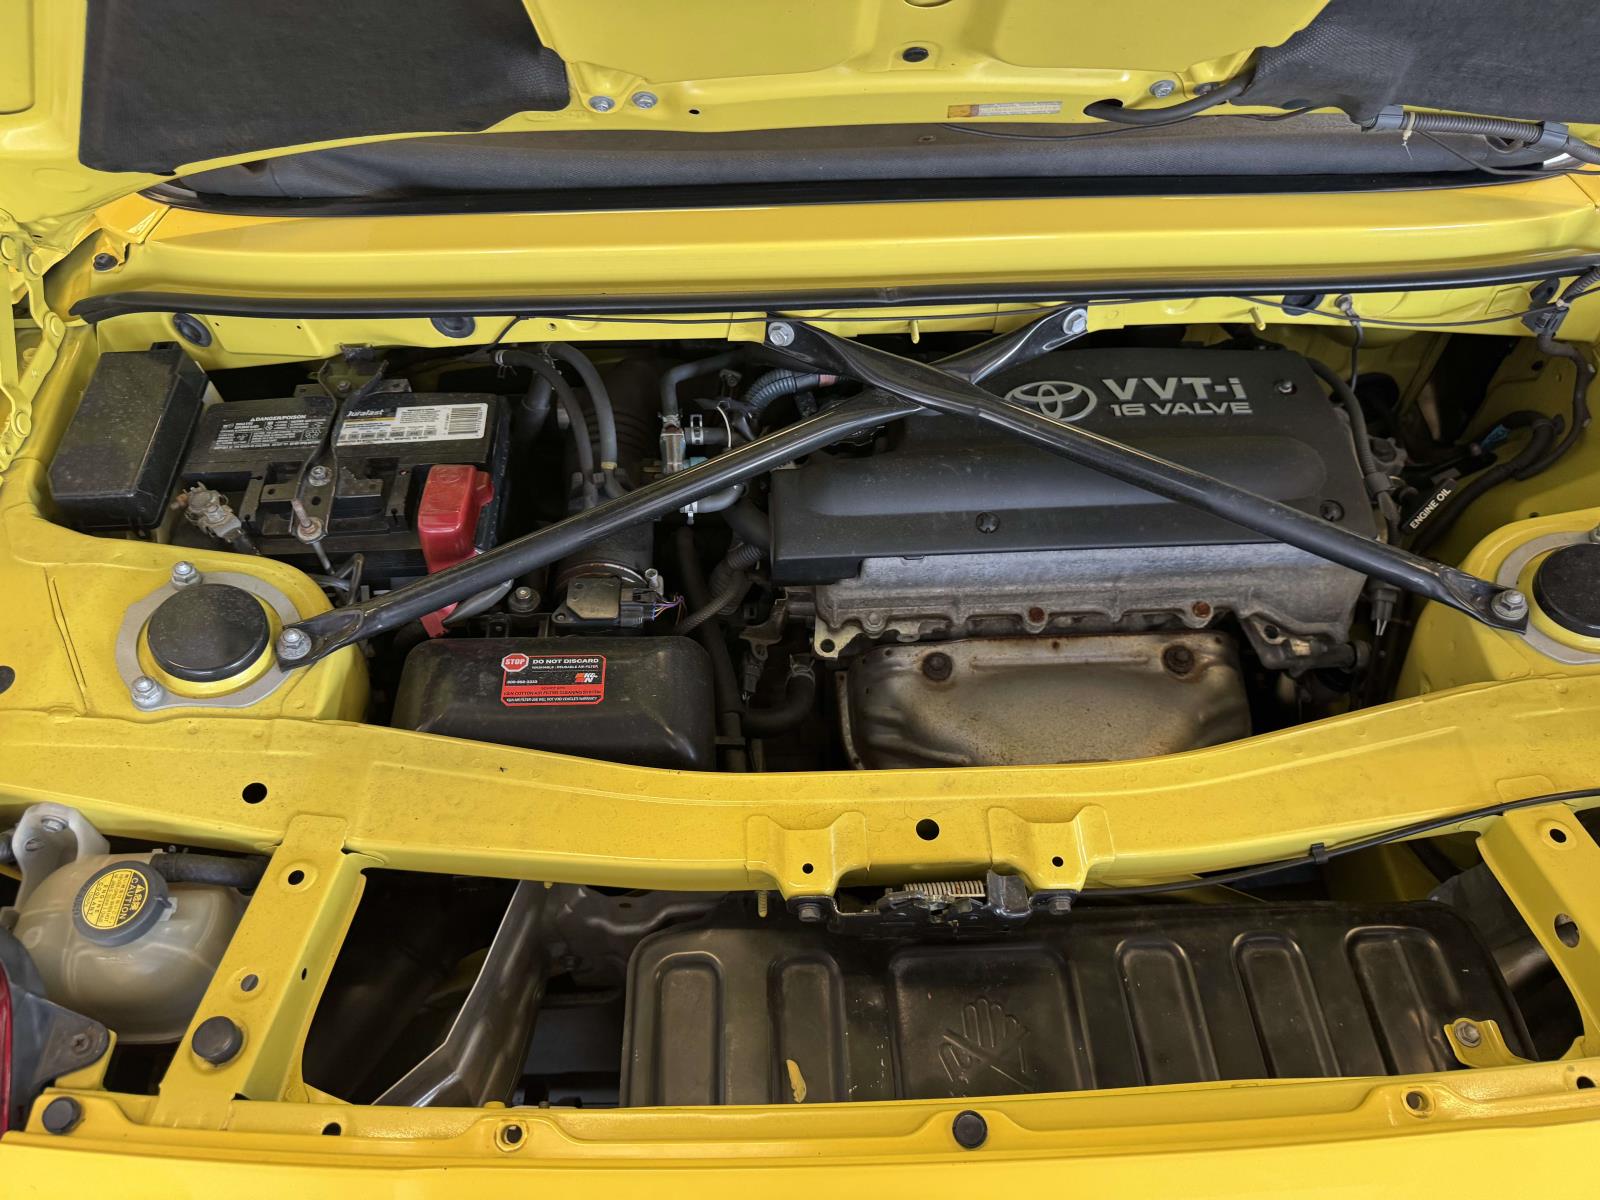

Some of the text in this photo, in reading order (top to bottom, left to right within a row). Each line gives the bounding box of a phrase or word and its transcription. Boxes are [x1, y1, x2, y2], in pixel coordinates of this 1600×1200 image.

[1102, 377, 1247, 400] VVT-i
[1110, 402, 1253, 416] 16 VALVE
[1409, 487, 1452, 529] ENGINE OIL
[119, 877, 139, 920] CAUTION
